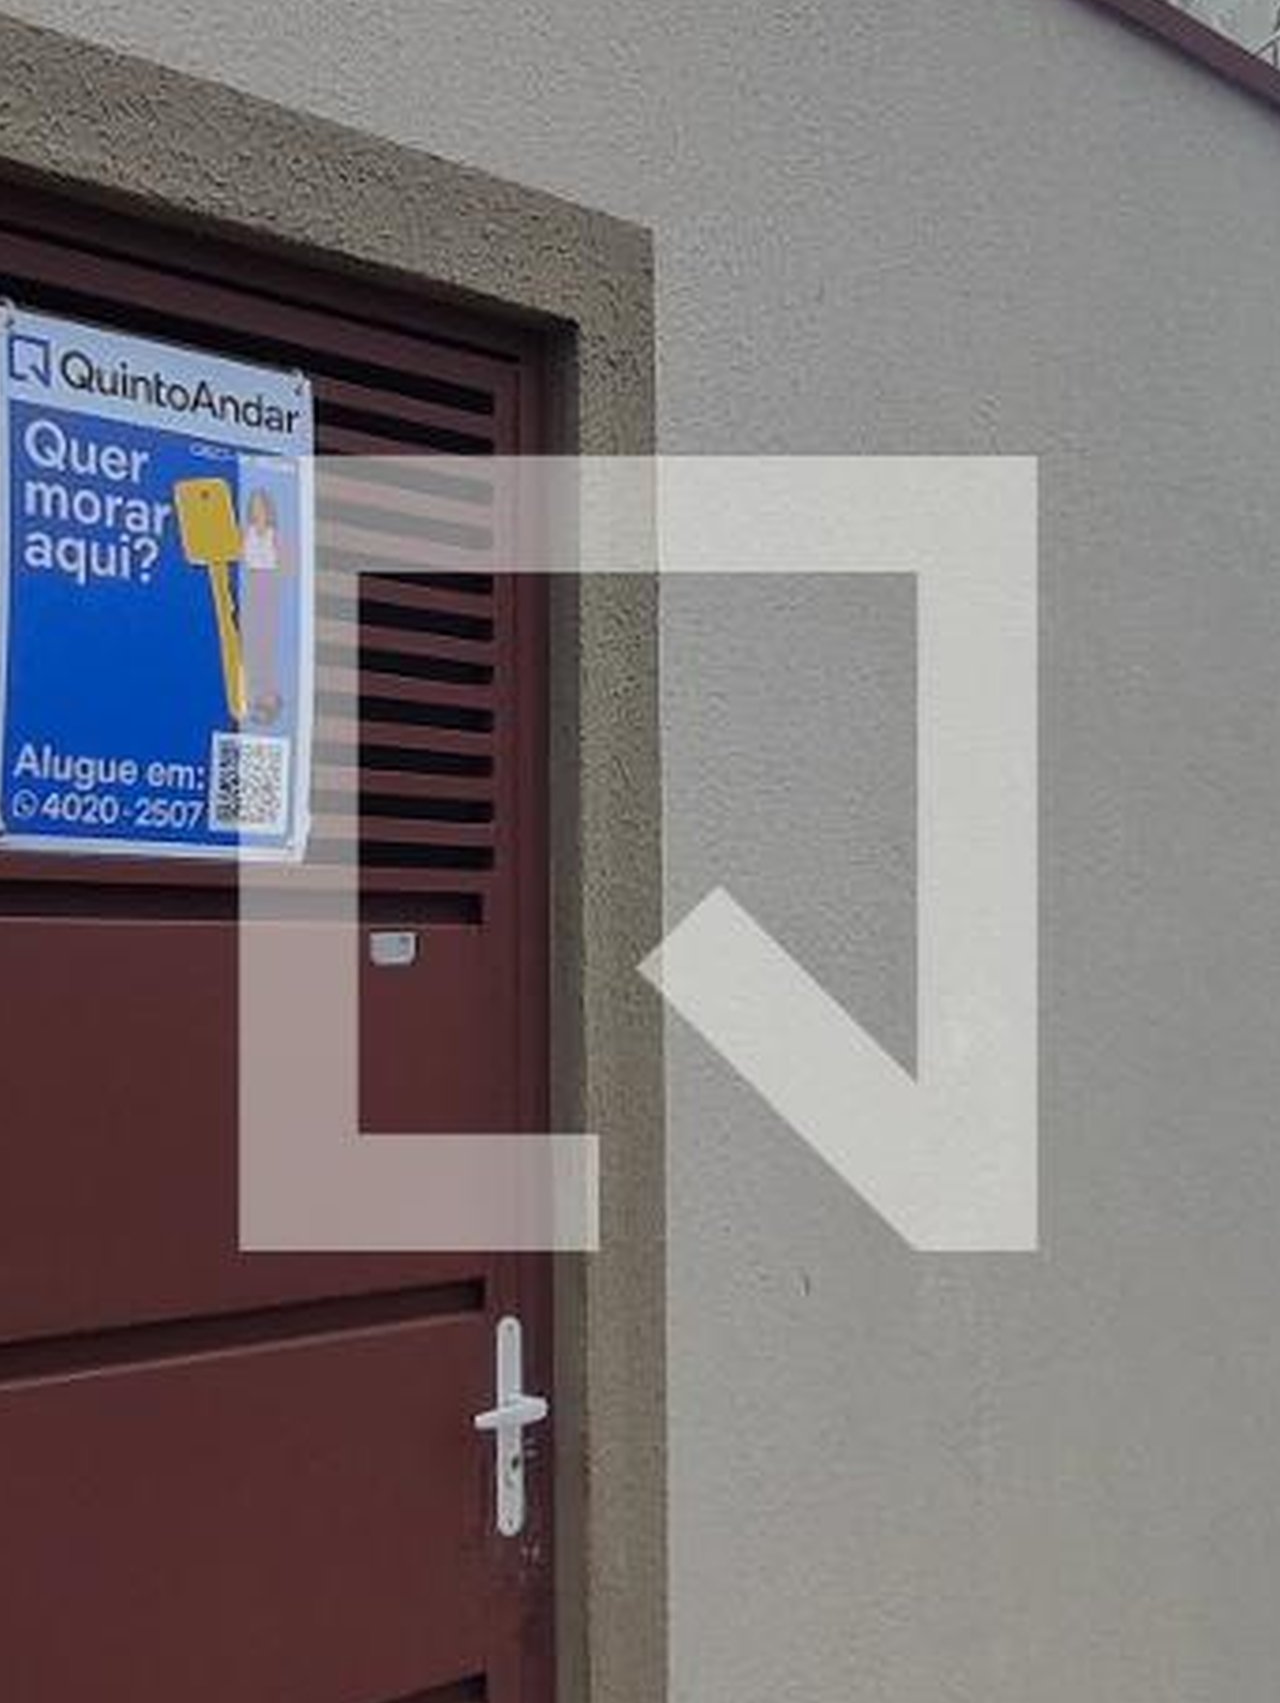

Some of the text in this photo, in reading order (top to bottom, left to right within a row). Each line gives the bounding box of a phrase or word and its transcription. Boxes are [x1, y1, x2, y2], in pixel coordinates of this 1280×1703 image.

[61, 350, 299, 434] QuintoAndar
[24, 419, 150, 484] Quer
[24, 480, 172, 535] morar
[24, 531, 159, 586] aqui?
[13, 743, 205, 791] Alugue em:
